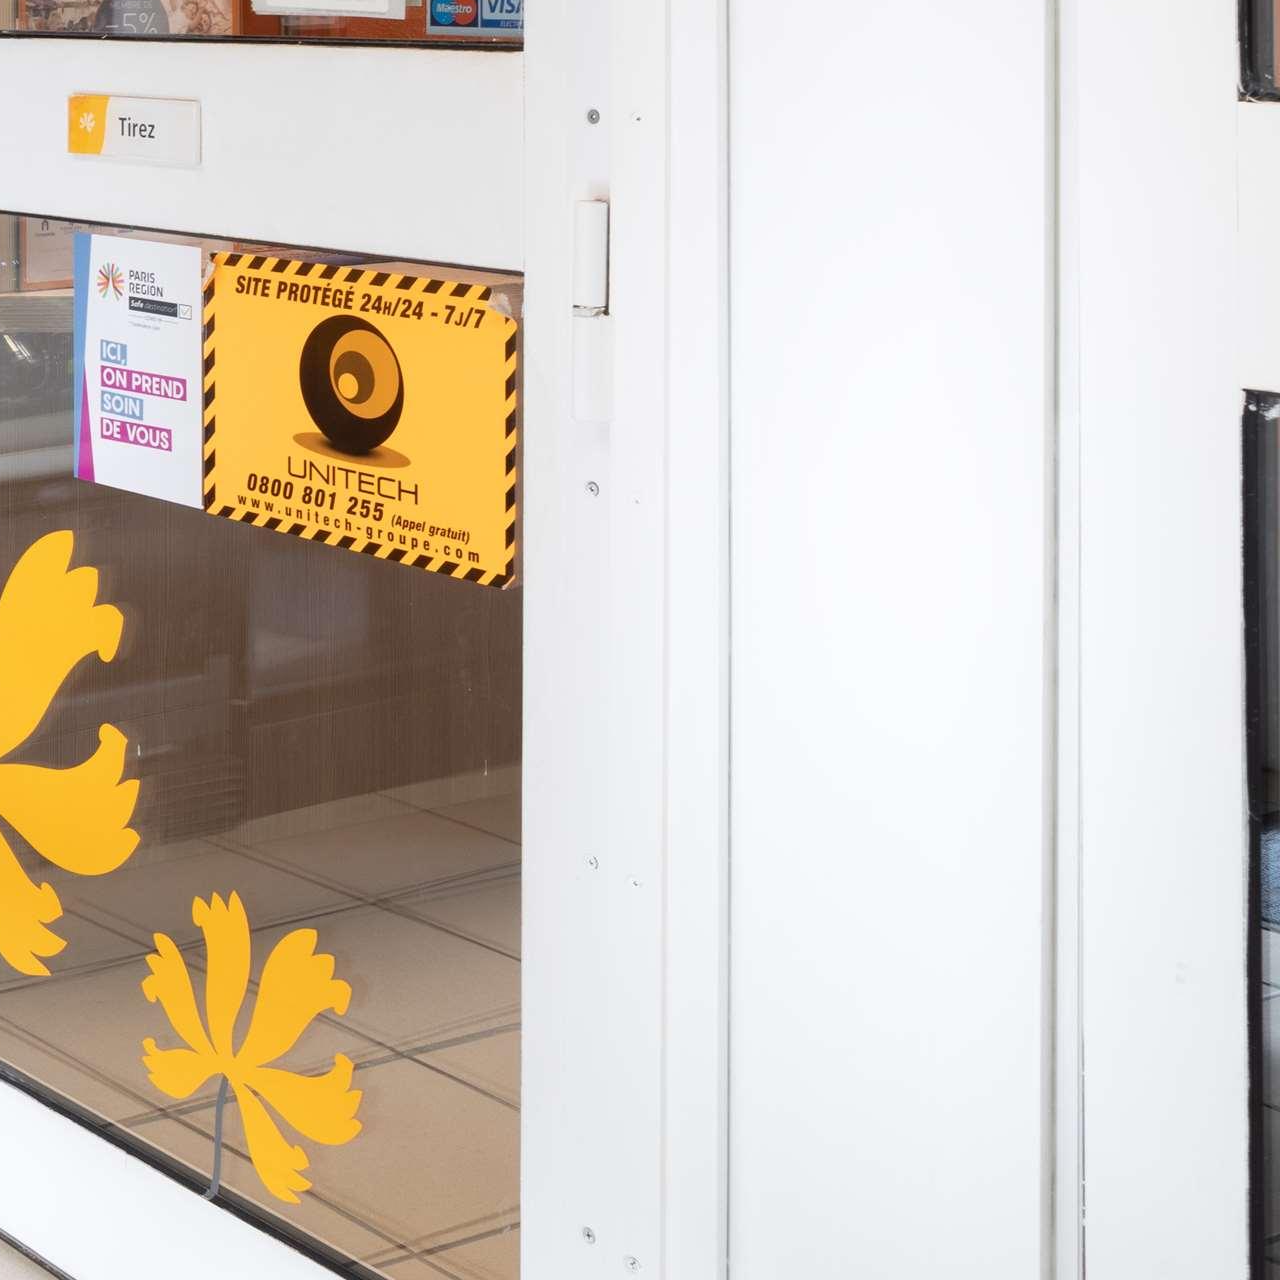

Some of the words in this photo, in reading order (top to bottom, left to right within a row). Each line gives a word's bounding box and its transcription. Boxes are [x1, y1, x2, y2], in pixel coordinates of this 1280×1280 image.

[436, 2, 472, 14] Maestro
[118, 116, 156, 140] Tirez
[128, 270, 156, 284] PARIS
[129, 282, 164, 298] REGION
[235, 274, 270, 297] SITE
[276, 280, 355, 310] PROTÉGÉ
[444, 305, 486, 330] 7J/7
[102, 344, 126, 365] ICI,
[103, 368, 127, 387] ON
[131, 372, 184, 399] PREND
[103, 394, 140, 417] SOIN
[102, 419, 121, 438] DE
[127, 423, 169, 450] VOUS
[287, 456, 420, 505] UNITECH
[247, 472, 294, 500] 0800
[302, 485, 337, 511] 801
[346, 496, 385, 522] 255
[390, 513, 424, 536] (Appel
[428, 524, 471, 545] gratuit)
[237, 495, 480, 564] www.unitech-groupe.com
